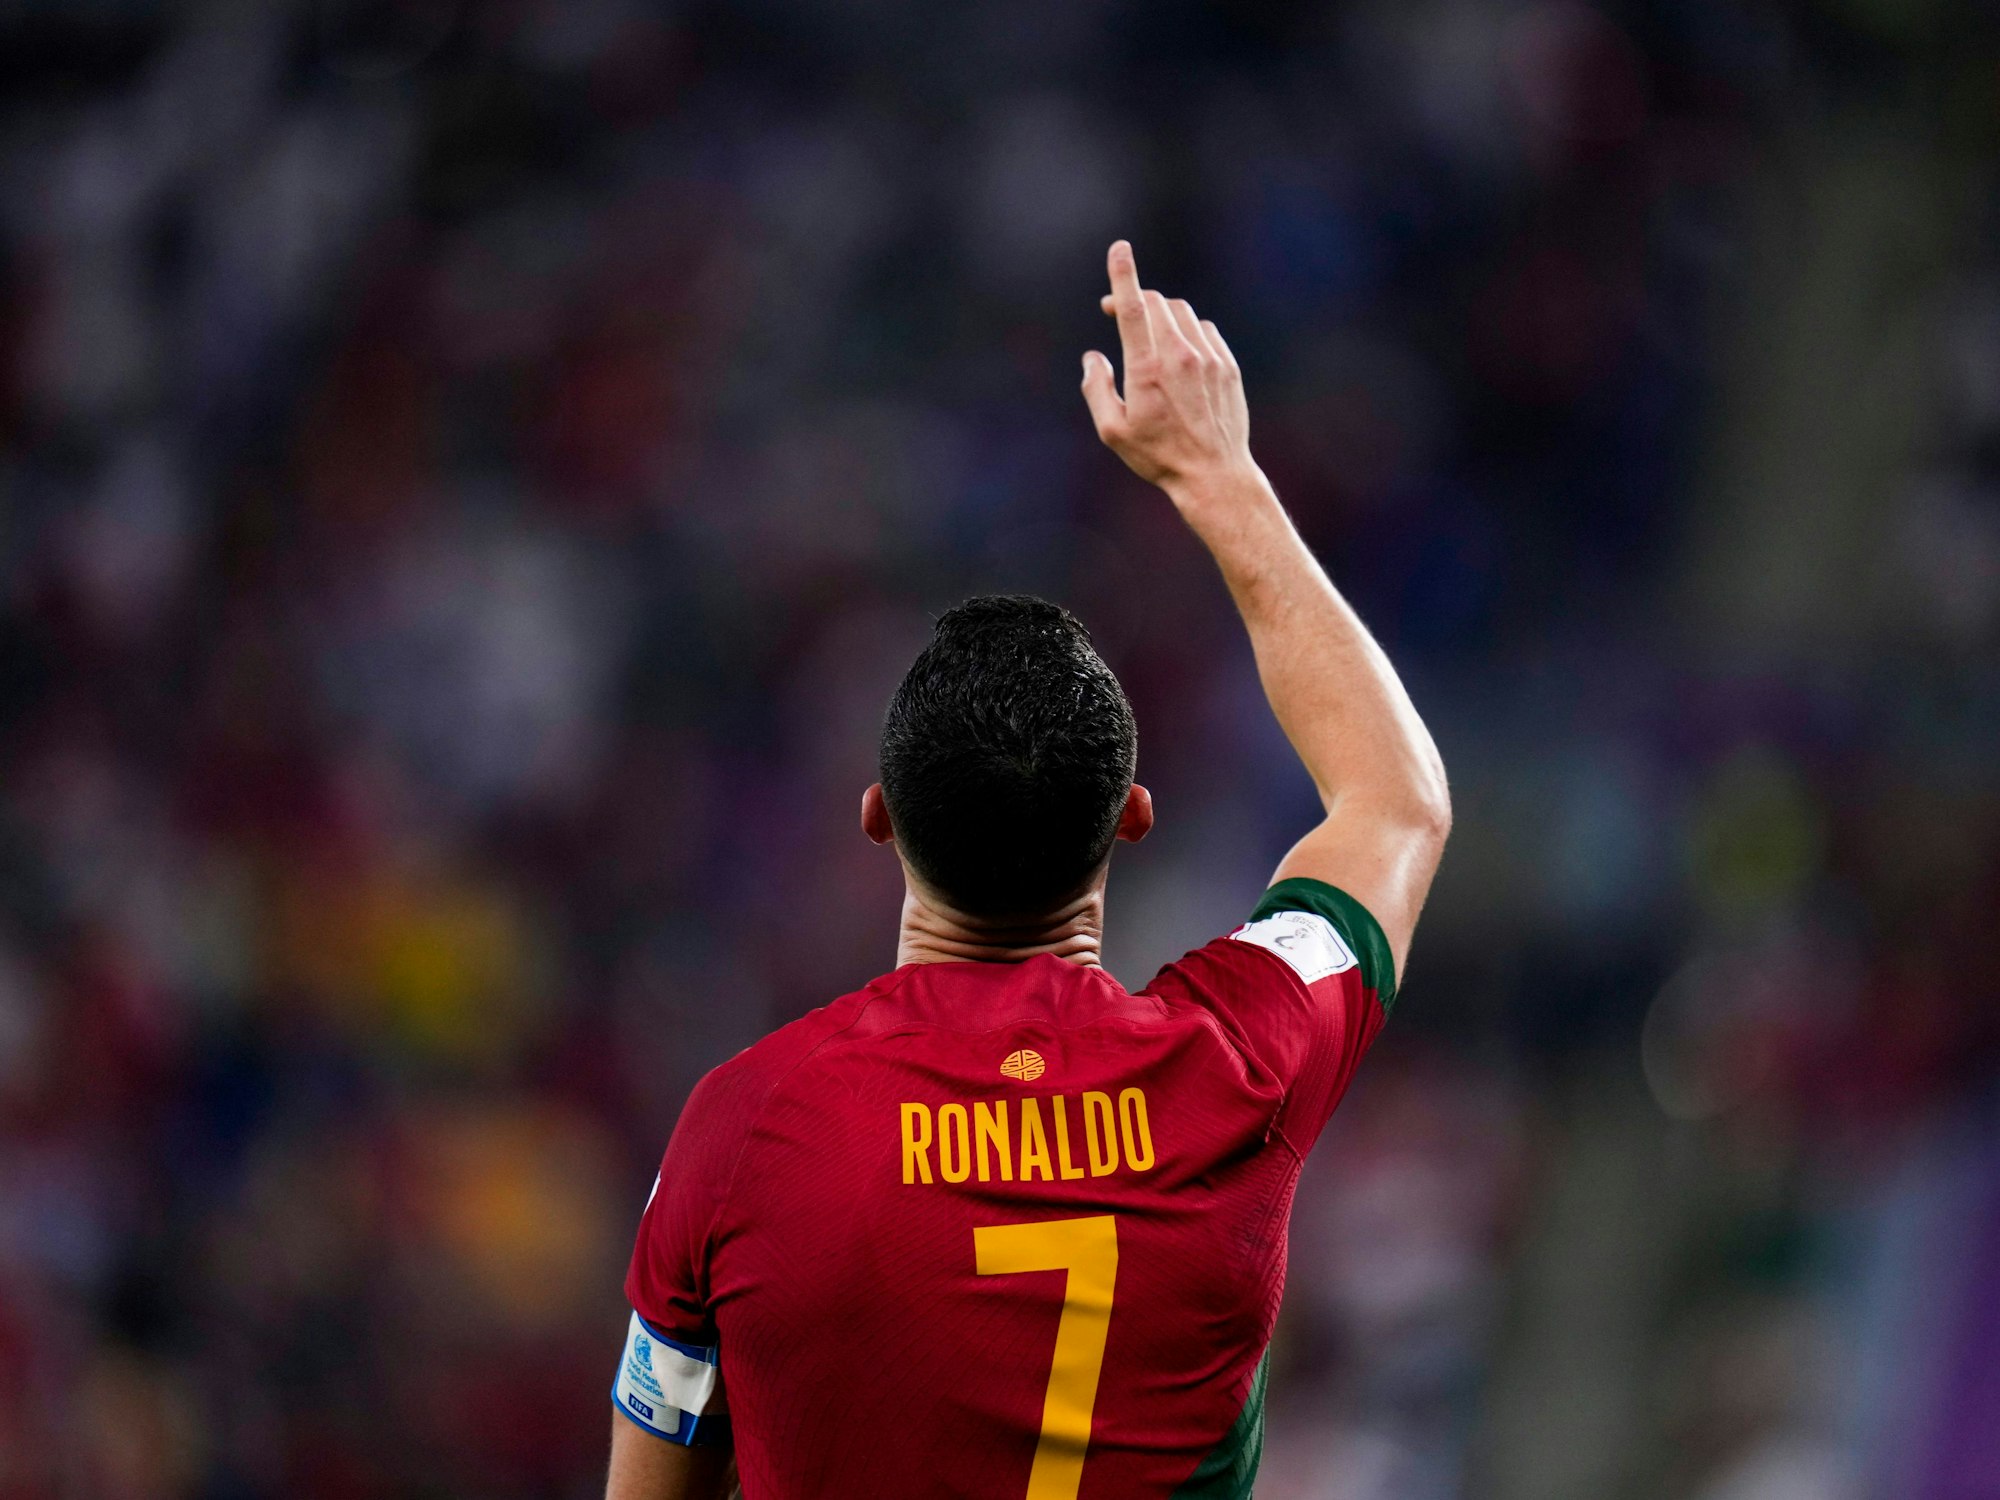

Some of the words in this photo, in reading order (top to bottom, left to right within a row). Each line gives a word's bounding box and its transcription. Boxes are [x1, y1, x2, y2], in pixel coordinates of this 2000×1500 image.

[900, 1087, 1156, 1185] RONALDO
[973, 1215, 1119, 1500] 7
[630, 1397, 649, 1417] FIFA
